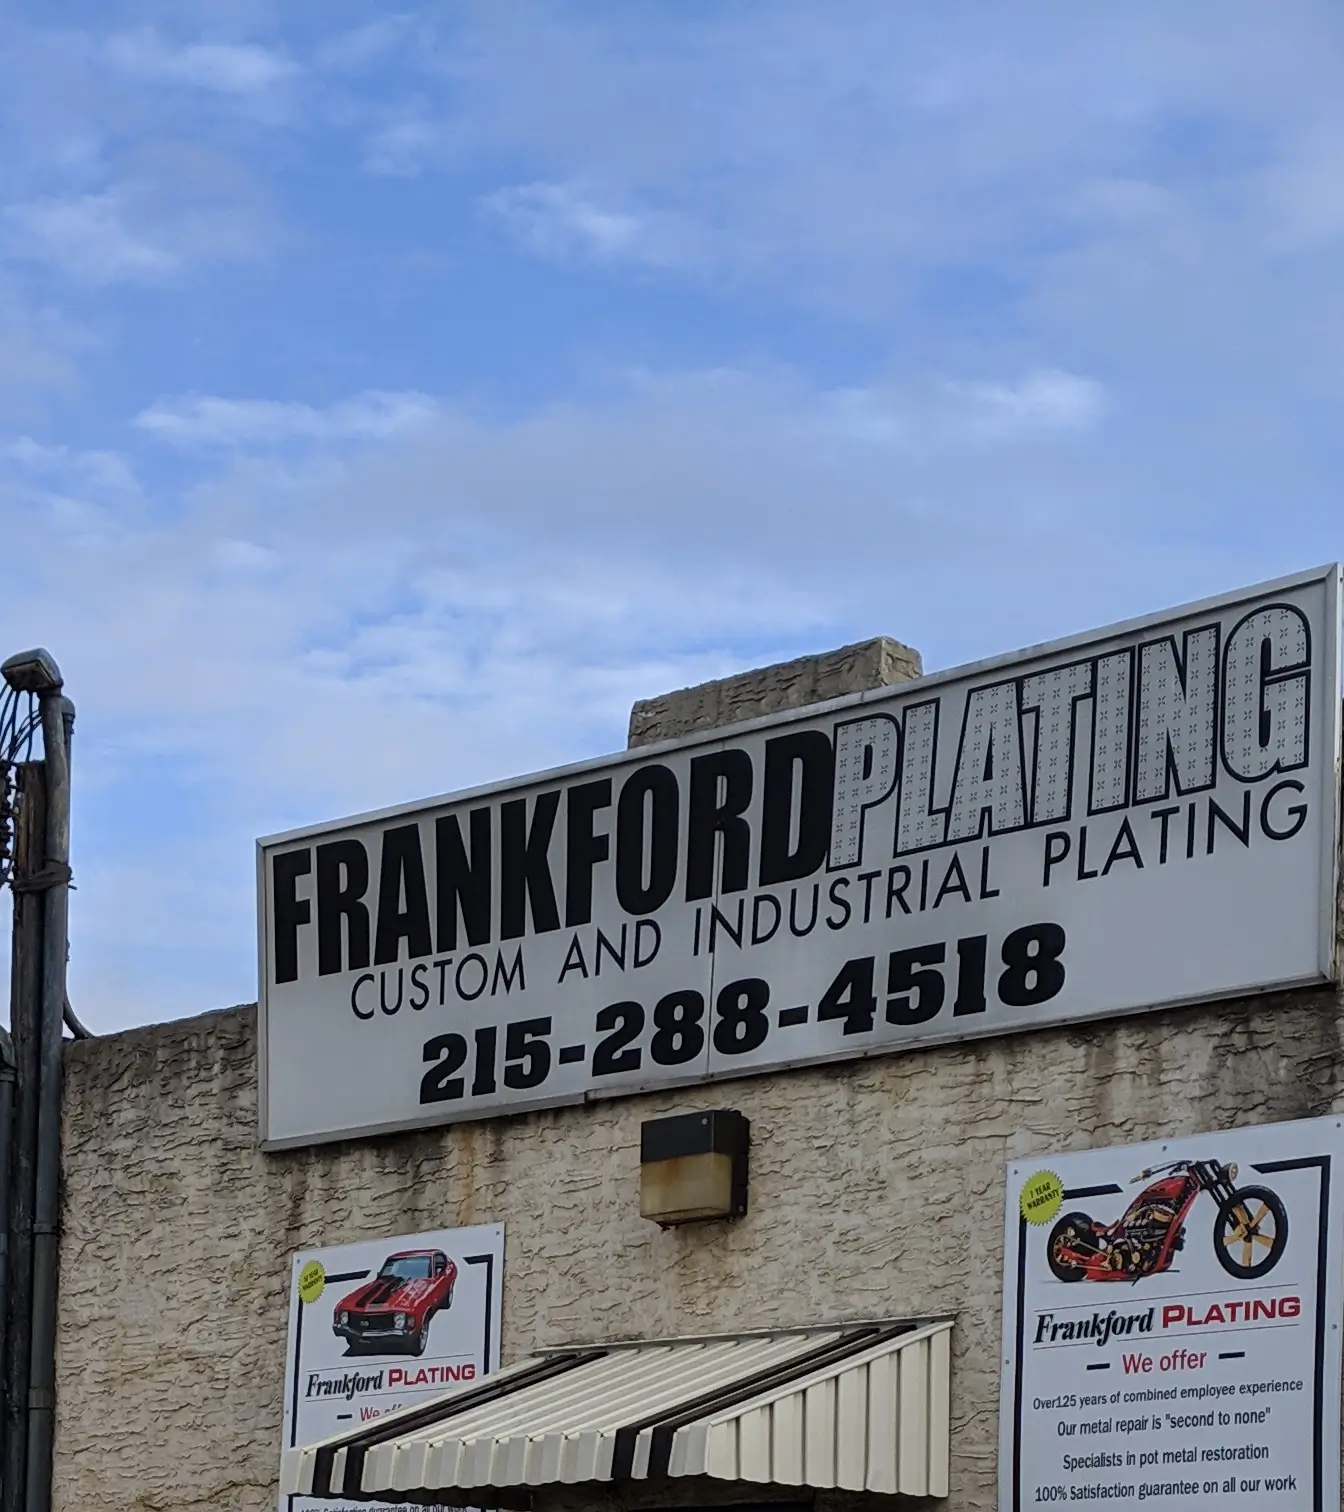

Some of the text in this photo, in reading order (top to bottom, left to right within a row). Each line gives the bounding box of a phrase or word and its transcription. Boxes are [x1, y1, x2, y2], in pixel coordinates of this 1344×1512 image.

[272, 603, 1312, 985] FRANKFORD PLATING
[350, 779, 1308, 1020] CUSTOM AND INDUSTRIAL PLATING
[419, 922, 1067, 1105] 215-288-4518
[1032, 1296, 1301, 1347] Frankford PLATING
[1122, 1349, 1207, 1375] We offer
[305, 1364, 476, 1401] Frankford PLATING
[1079, 1394, 1107, 1410] years
[1109, 1391, 1121, 1403] of
[1123, 1387, 1177, 1403] combined
[1181, 1384, 1235, 1400] employee
[1239, 1379, 1303, 1396] experience
[1057, 1407, 1271, 1436] Our metal repair is "second to none"
[1063, 1443, 1269, 1472] Specialists in pot metal restoration
[1035, 1474, 1297, 1502] 100% Satisfaction guarantee on all our work
